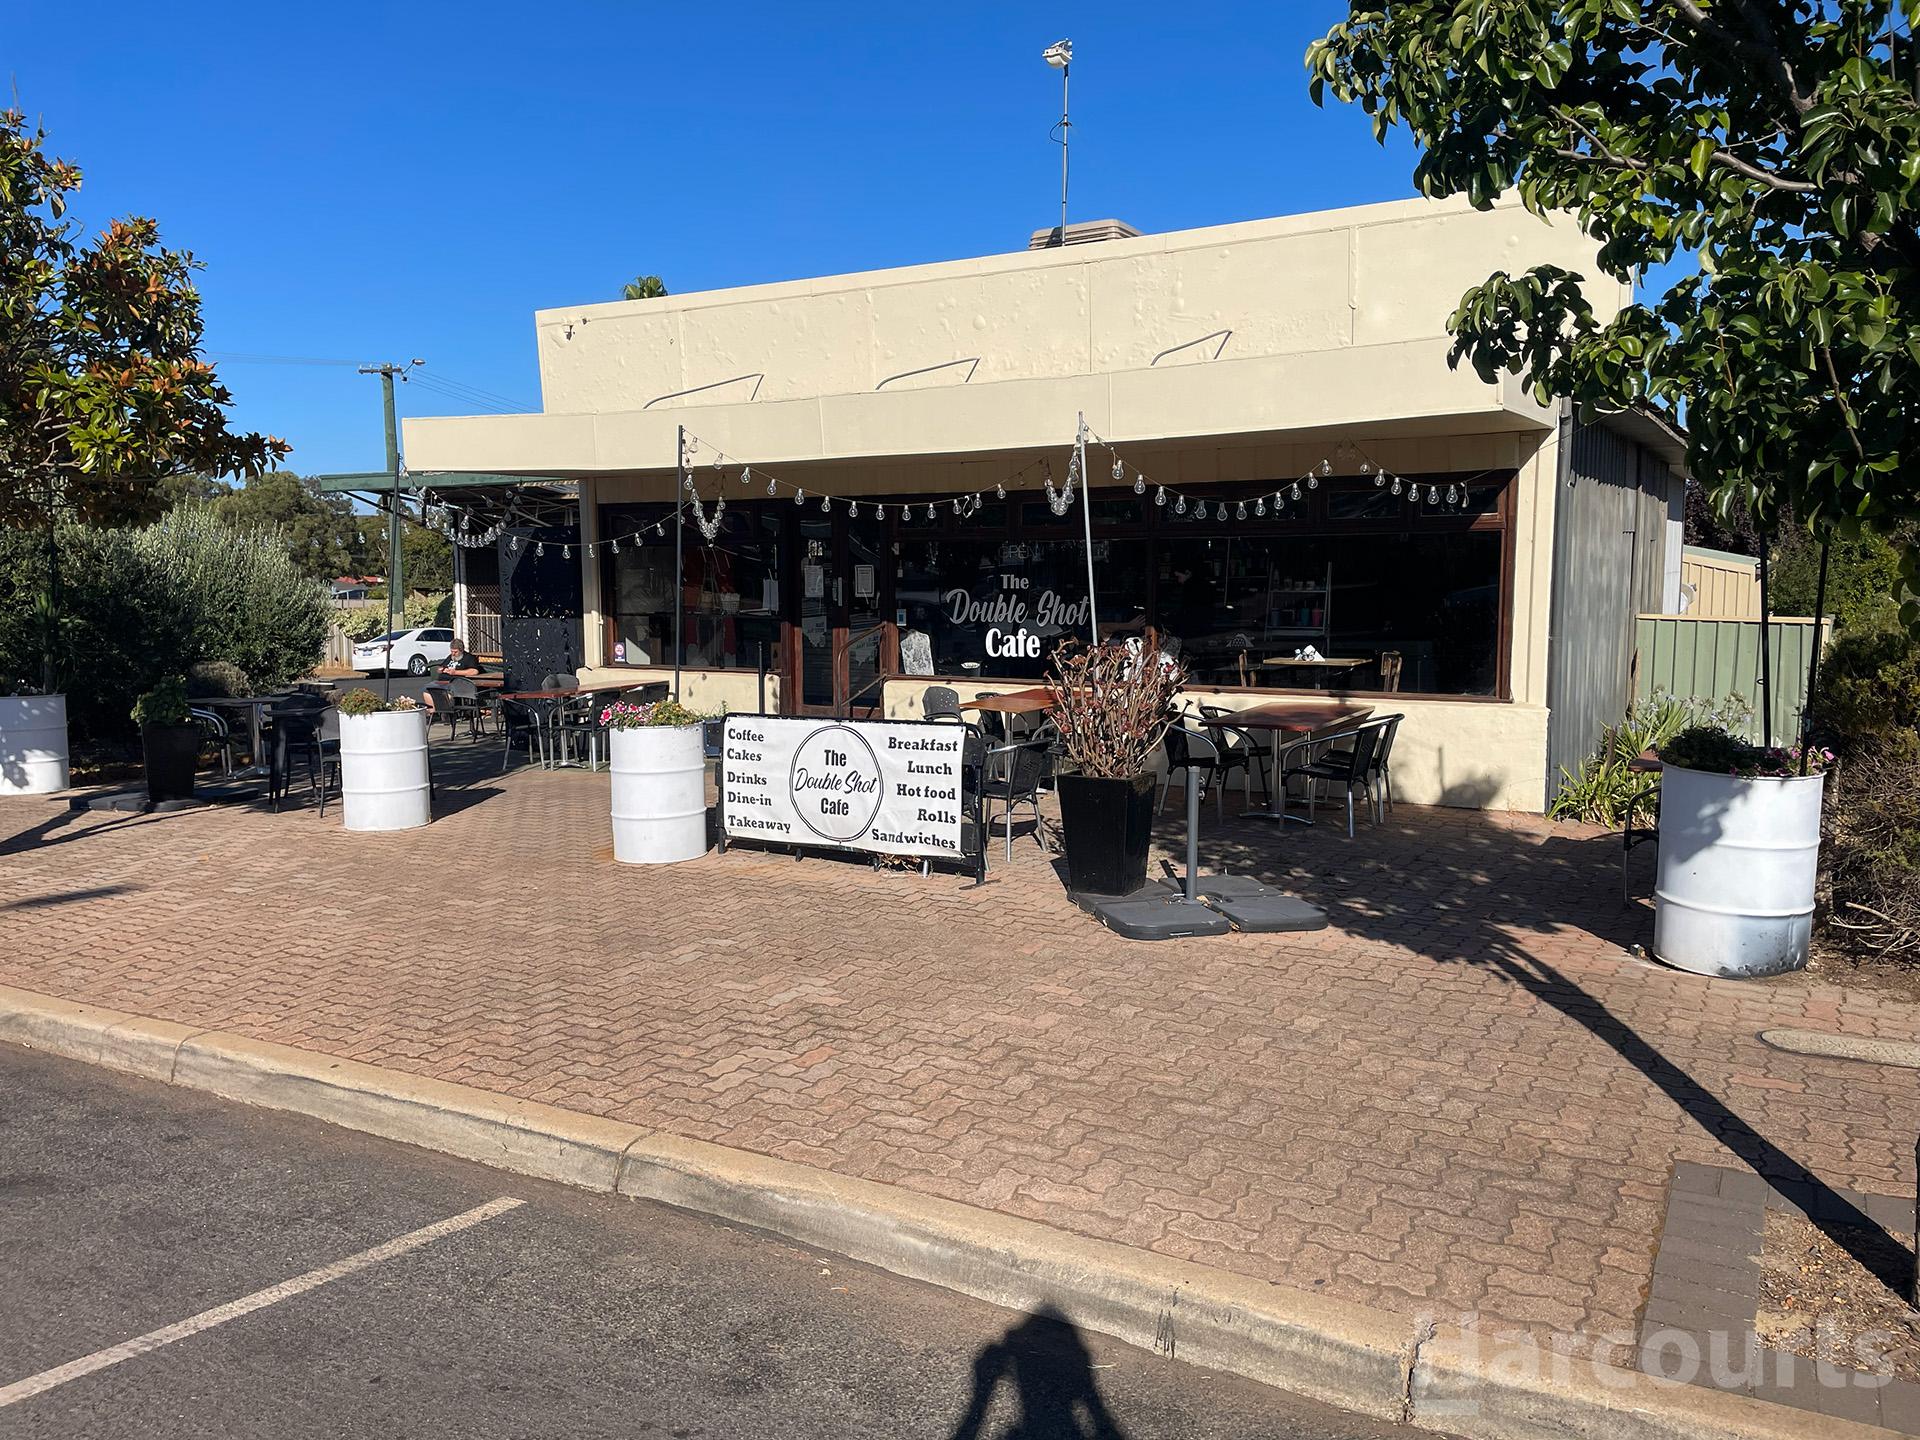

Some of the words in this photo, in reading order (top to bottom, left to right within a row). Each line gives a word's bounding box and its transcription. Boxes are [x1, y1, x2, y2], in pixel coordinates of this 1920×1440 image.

[1000, 574, 1030, 590] The
[945, 588, 1029, 625] Double
[1036, 589, 1090, 627] Shot
[985, 628, 1041, 658] Cafe
[728, 728, 764, 743] Coffee
[888, 737, 958, 752] Breakfast
[727, 748, 762, 762] Cakes
[824, 749, 847, 767] The
[907, 761, 953, 776] Lunch
[727, 771, 767, 786] Drinks
[794, 767, 843, 792] Double
[844, 771, 878, 794] Shot
[727, 791, 772, 807] Dine-in
[896, 784, 922, 798] Hot
[923, 786, 956, 801] food
[820, 798, 849, 816] Cafe
[728, 815, 791, 833] Takeaway
[917, 808, 957, 824] Rolls
[871, 828, 956, 850] Sandwiches
